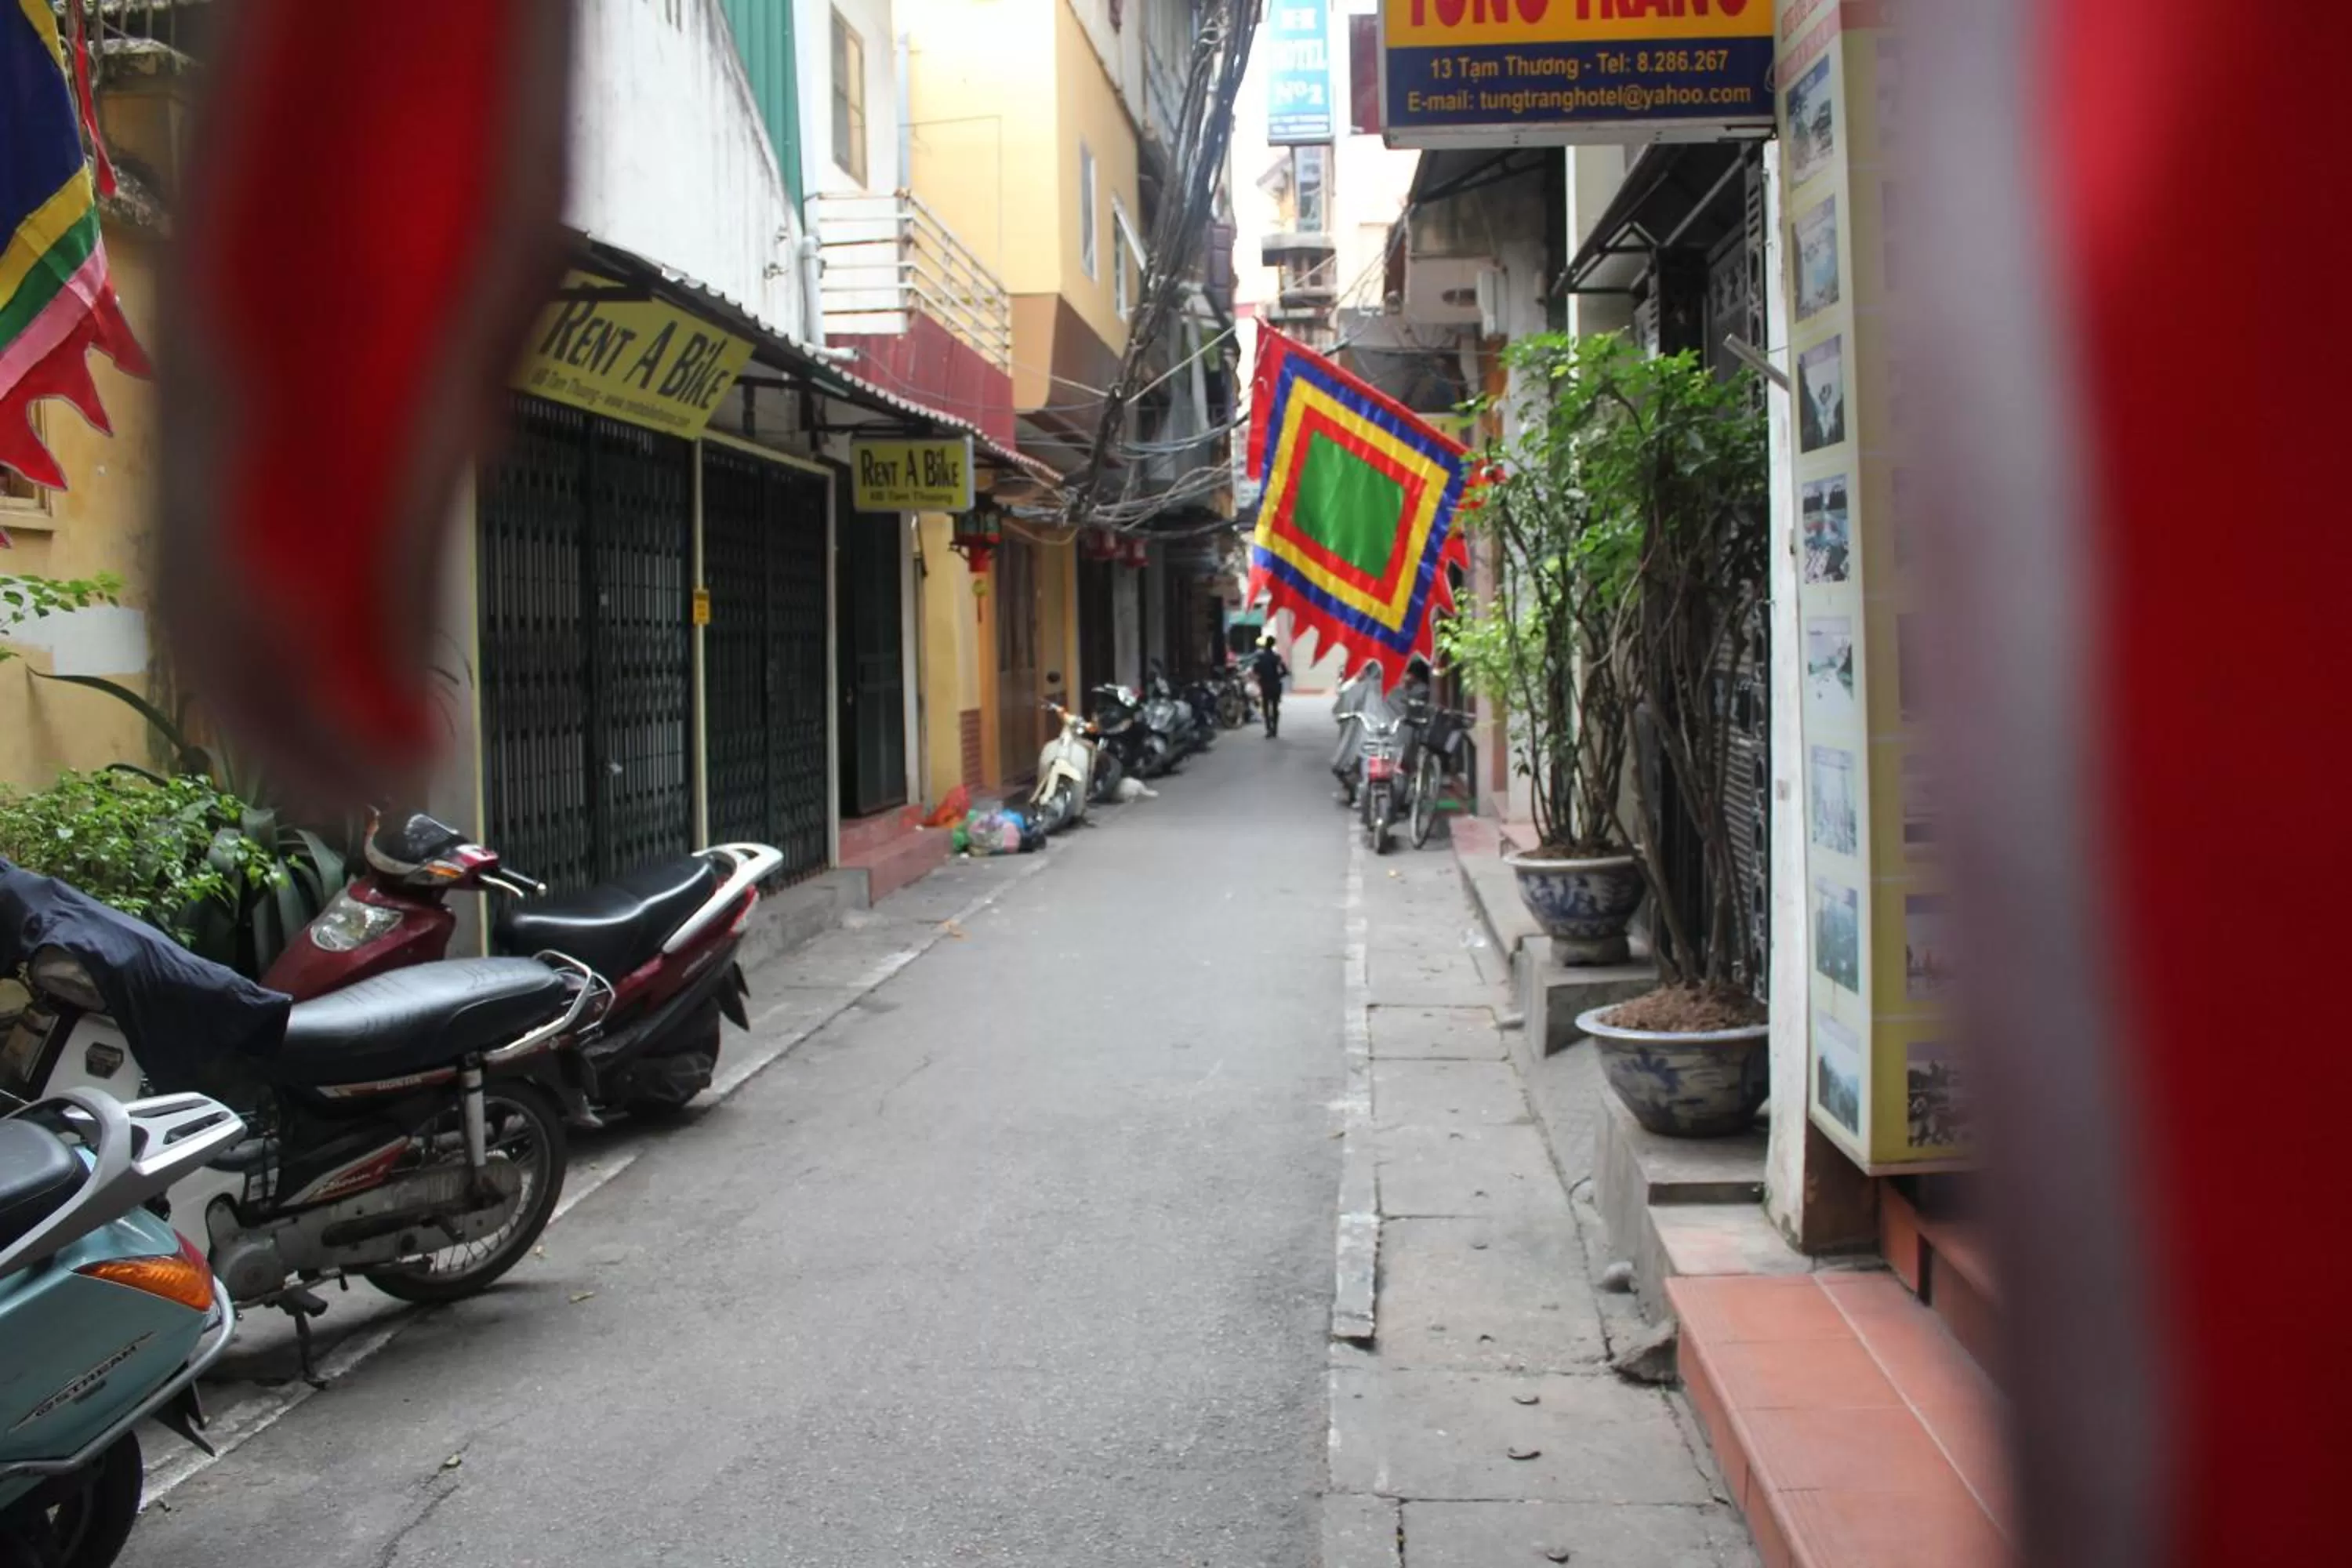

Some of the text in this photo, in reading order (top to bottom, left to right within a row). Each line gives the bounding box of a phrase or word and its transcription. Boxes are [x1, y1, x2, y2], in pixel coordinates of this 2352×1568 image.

[1430, 57, 1453, 79] 13
[1596, 52, 1631, 74] Tel:
[1636, 49, 1729, 73] 8.286.267
[1407, 83, 1751, 114] E-mail: tungtranghotel@yahoo.com
[622, 320, 678, 390] A
[906, 448, 919, 488] A
